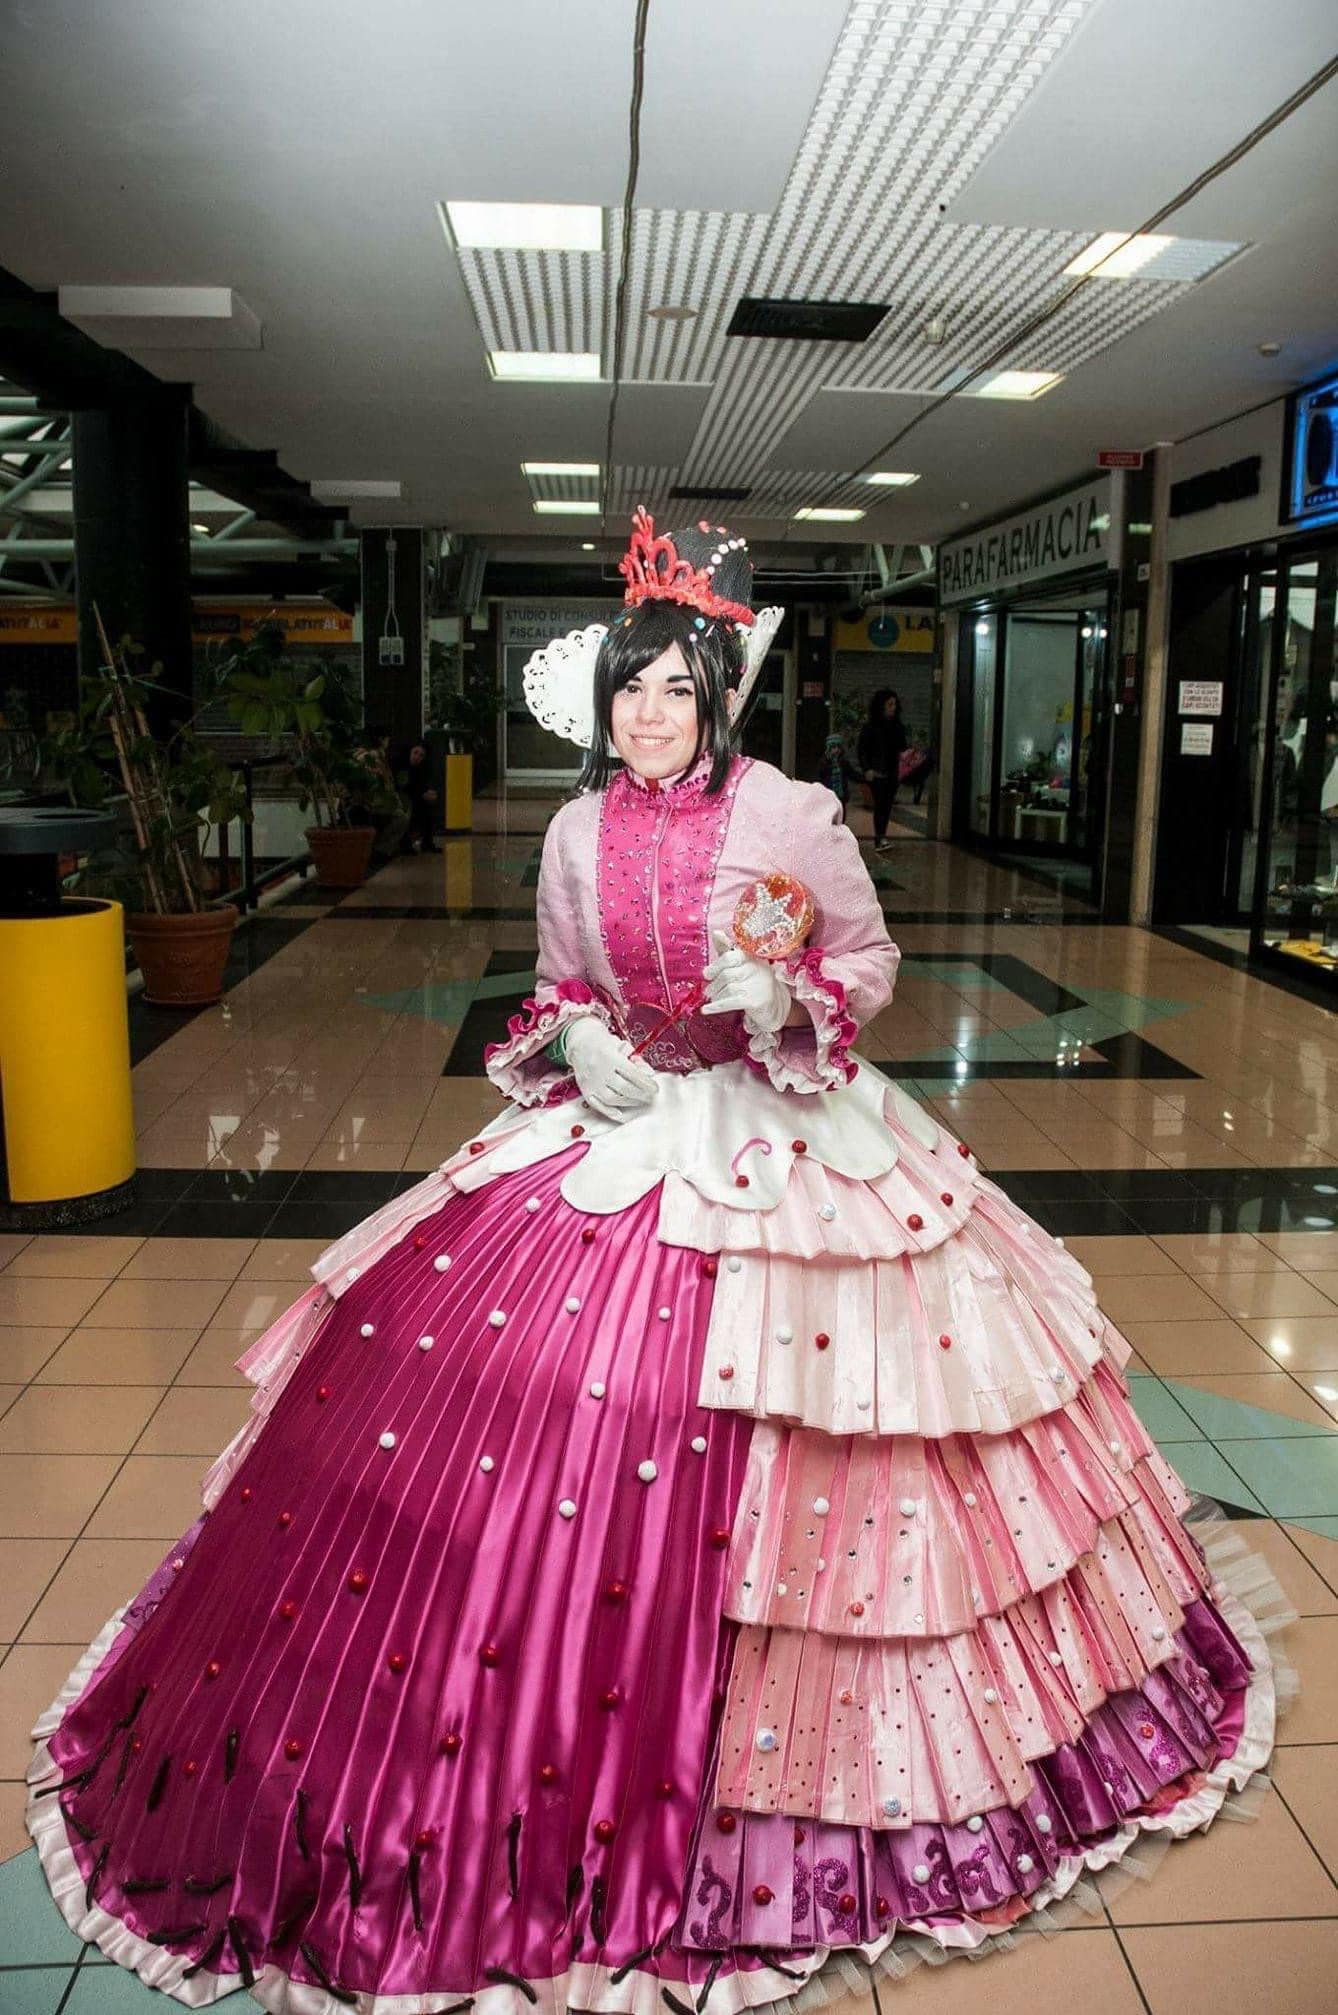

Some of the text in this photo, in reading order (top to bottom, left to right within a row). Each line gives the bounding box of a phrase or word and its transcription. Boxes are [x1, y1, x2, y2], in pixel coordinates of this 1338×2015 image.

[944, 498, 1101, 593] PARAFARMACIA
[505, 608, 546, 622] STUDIO
[550, 608, 561, 622] DI
[510, 626, 555, 638] FISCALE
